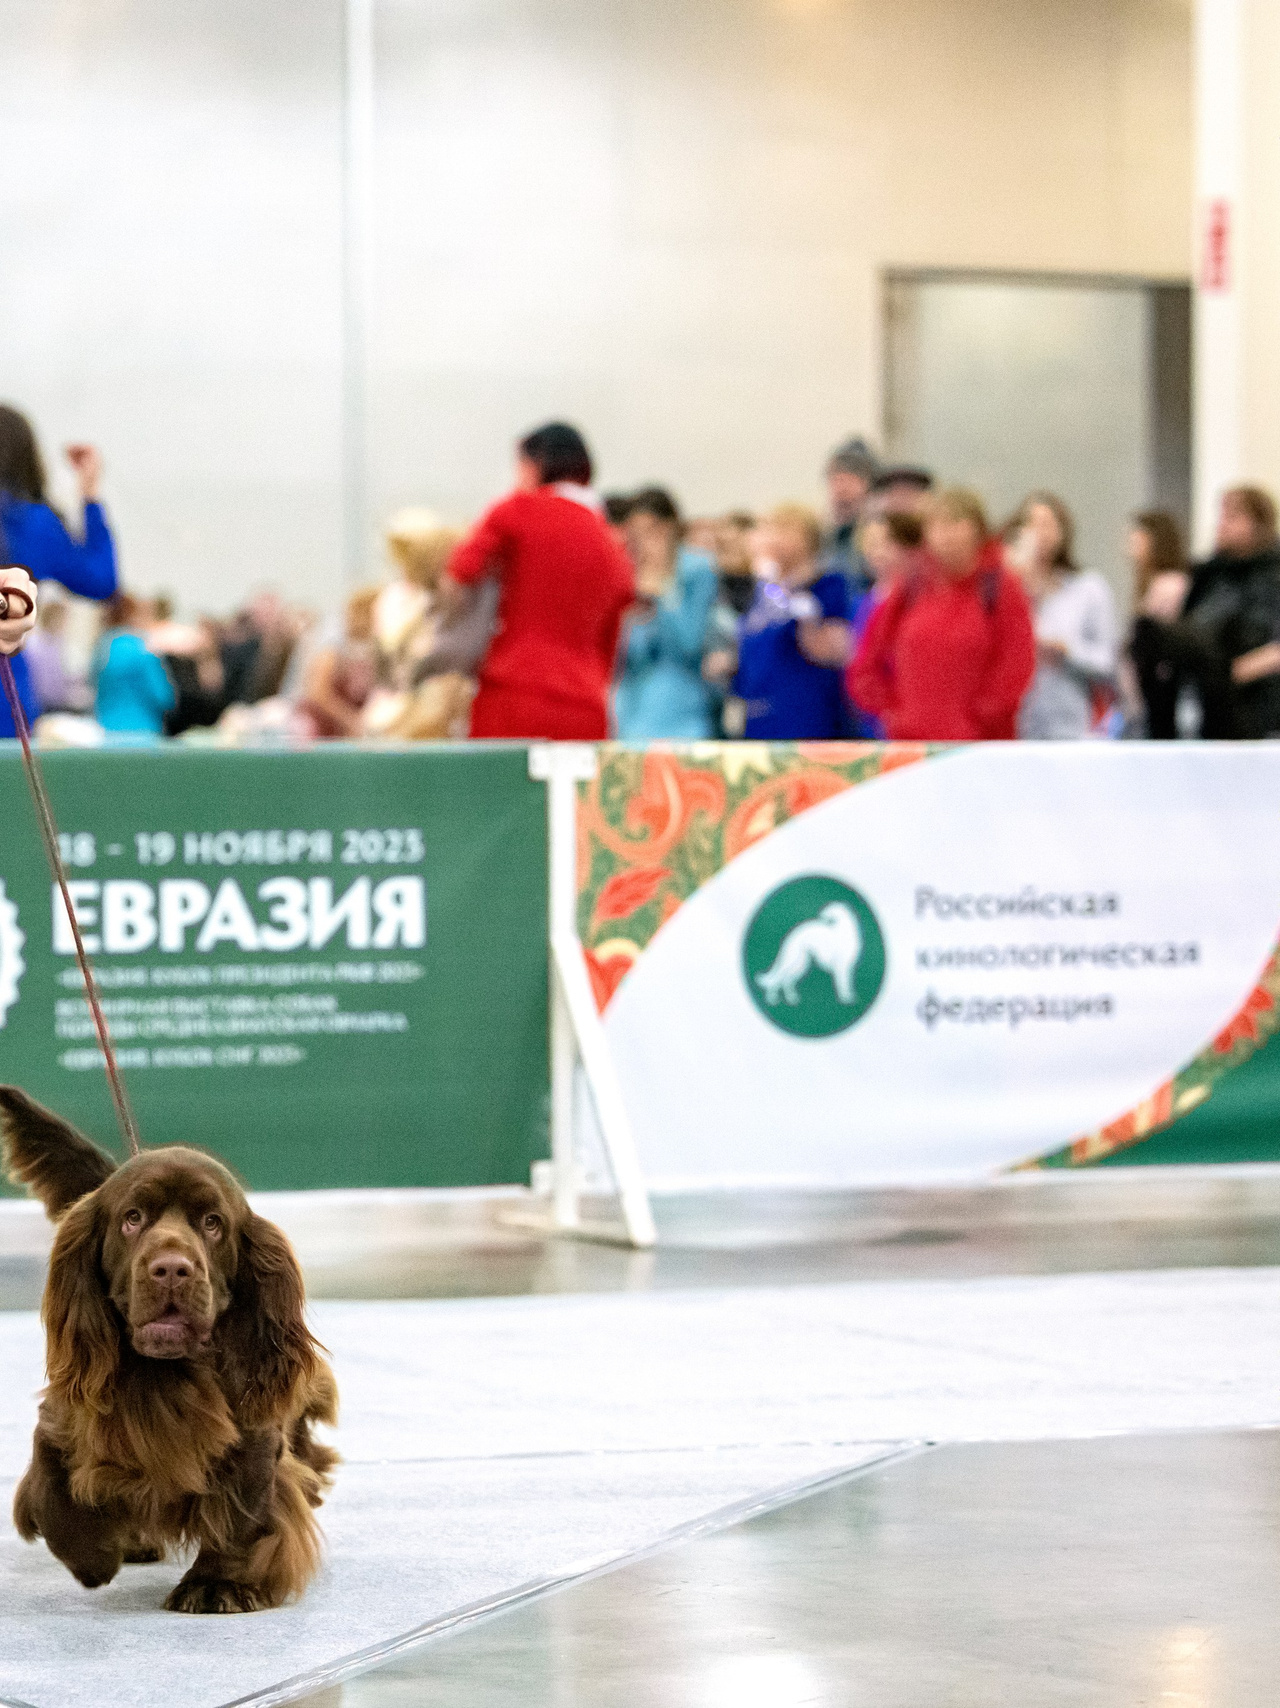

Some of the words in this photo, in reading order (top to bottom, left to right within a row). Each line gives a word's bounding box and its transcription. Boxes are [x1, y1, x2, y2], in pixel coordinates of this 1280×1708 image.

[134, 831, 176, 866] 19
[183, 829, 333, 865] НОЯБРЯ
[341, 828, 425, 864] 2023
[52, 876, 426, 954] ЕВРАЗИЯ
[915, 941, 1200, 970] кинологическая
[916, 985, 1116, 1034] федерация
